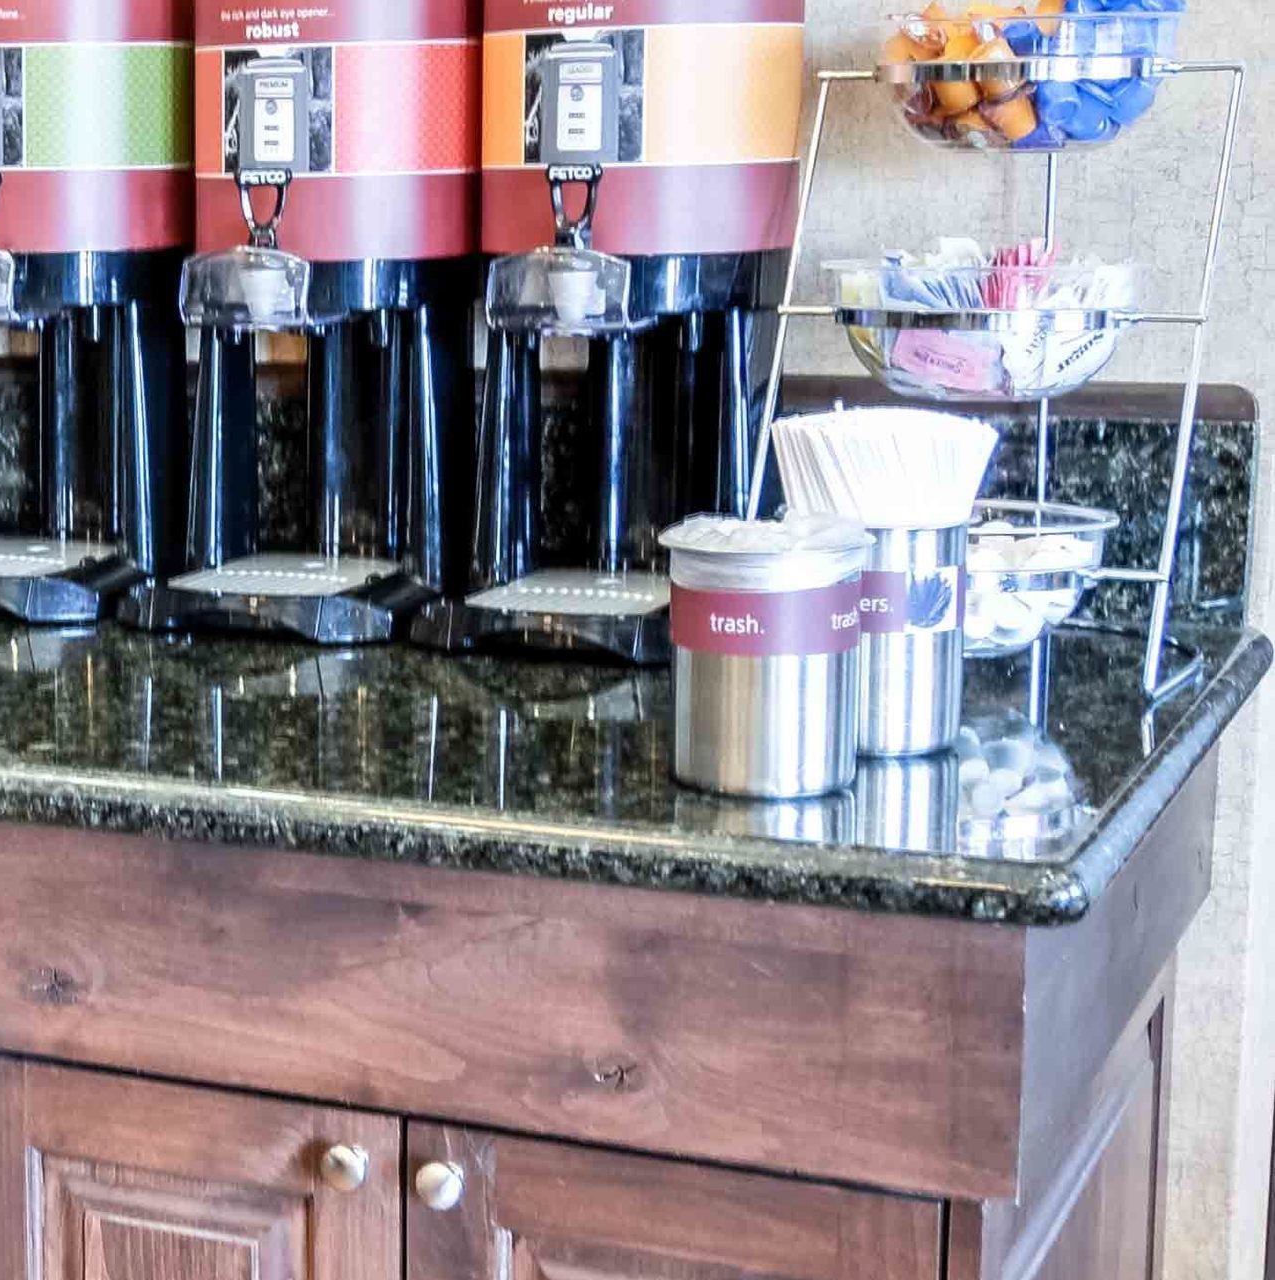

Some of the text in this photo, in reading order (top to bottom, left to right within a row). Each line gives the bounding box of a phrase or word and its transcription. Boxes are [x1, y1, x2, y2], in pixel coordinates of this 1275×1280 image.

[245, 8, 260, 21] and
[547, 3, 614, 24] regular
[246, 21, 299, 39] robust
[240, 170, 287, 185] FETCO
[549, 166, 593, 181] FETCO
[709, 612, 765, 635] trash.
